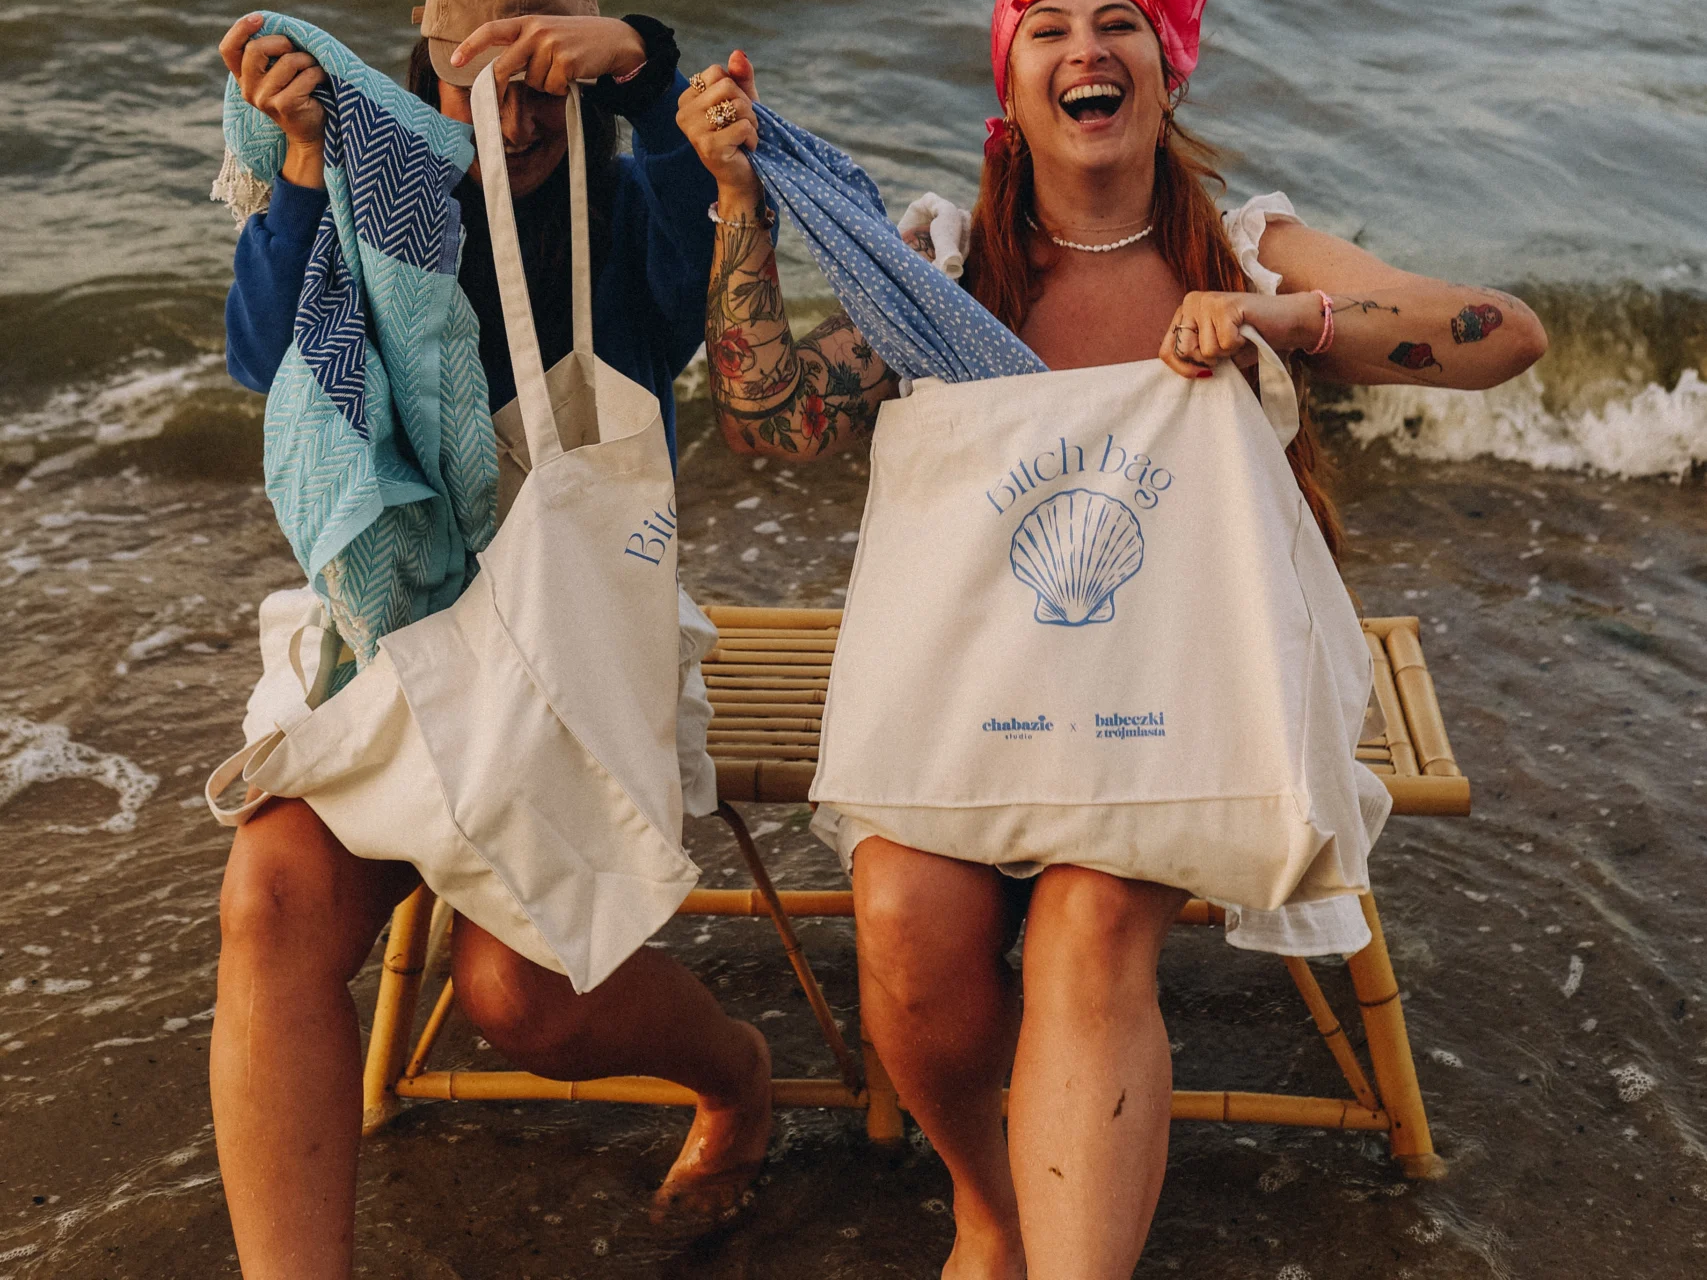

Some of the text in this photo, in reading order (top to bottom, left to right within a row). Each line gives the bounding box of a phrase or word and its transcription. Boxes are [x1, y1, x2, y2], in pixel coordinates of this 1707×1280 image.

[1098, 434, 1176, 510] bag
[982, 715, 1054, 731] chabazie
[1095, 711, 1164, 727] babeczki
